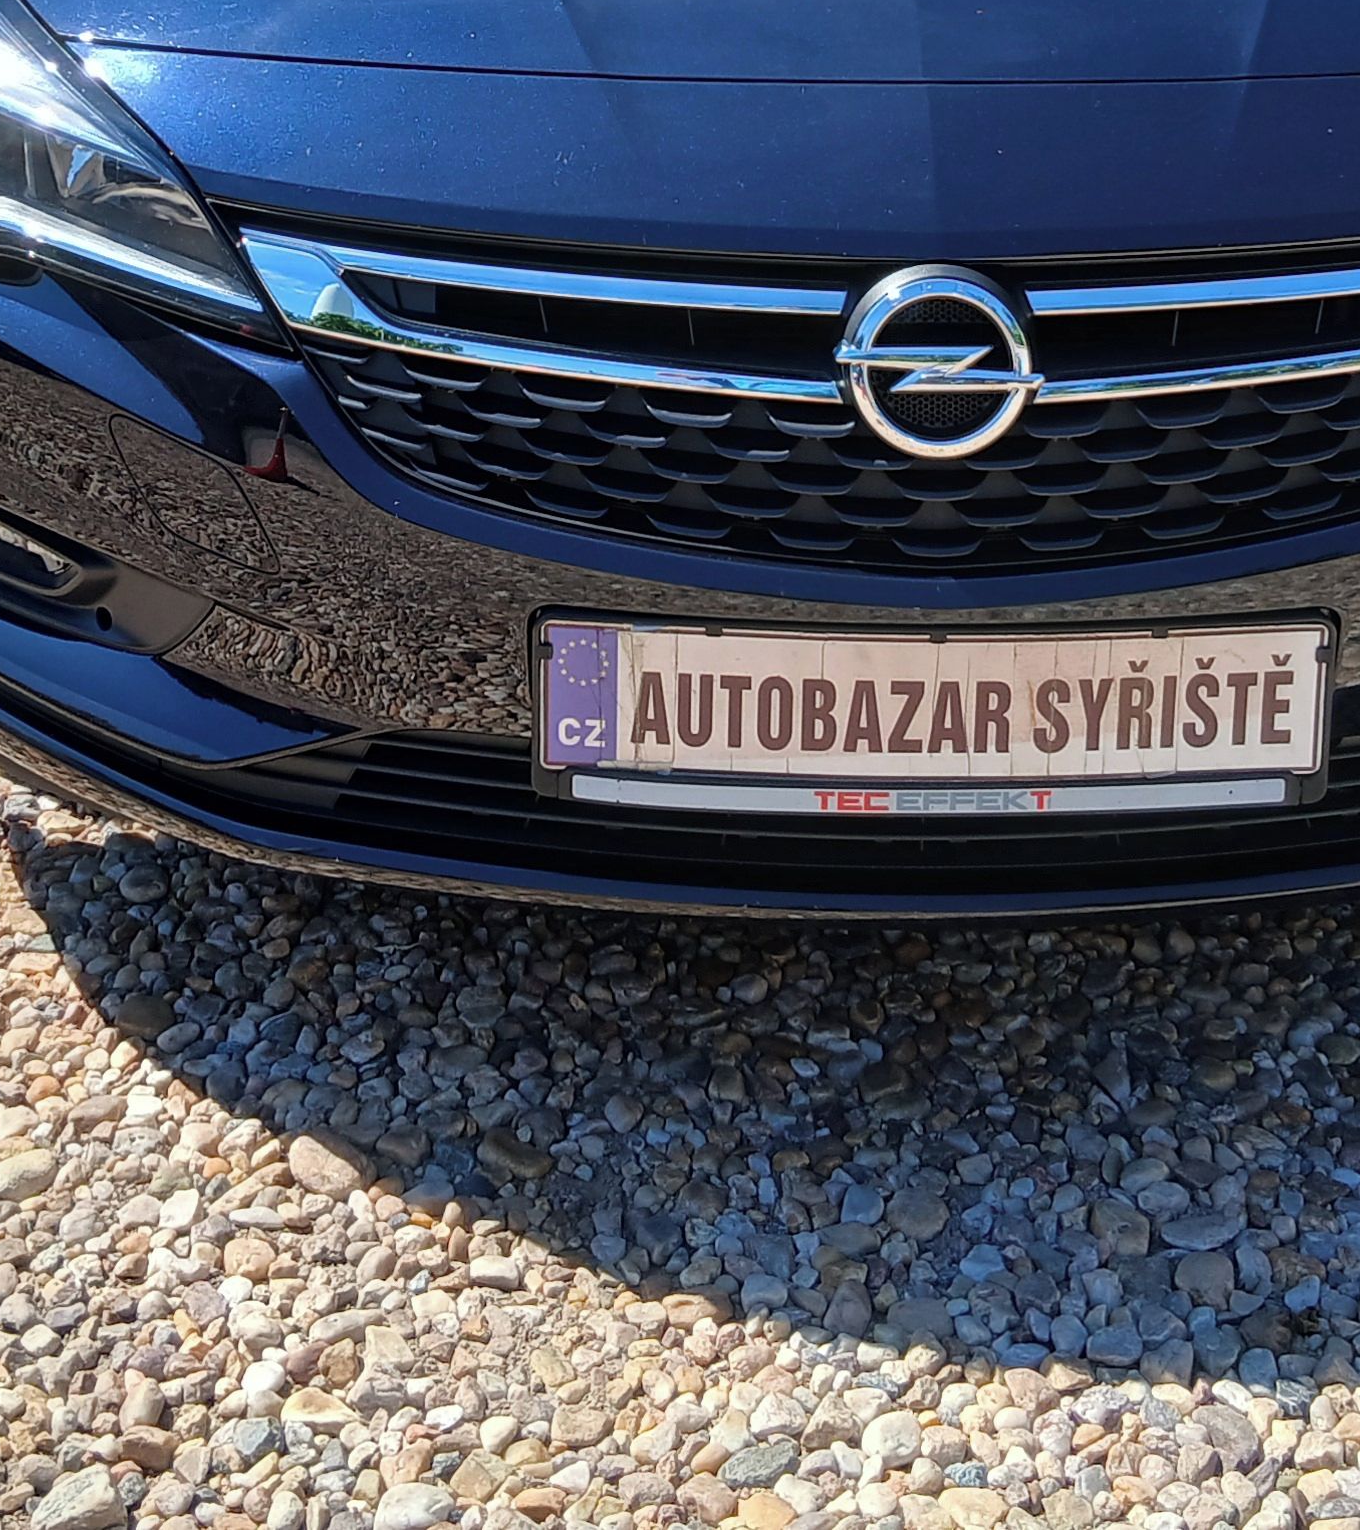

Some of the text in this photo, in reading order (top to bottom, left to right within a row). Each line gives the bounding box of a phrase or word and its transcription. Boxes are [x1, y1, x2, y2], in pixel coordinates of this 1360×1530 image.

[558, 717, 606, 748] CZ
[630, 654, 1295, 754] AUTOBAZAR SYŘIŠTĚ
